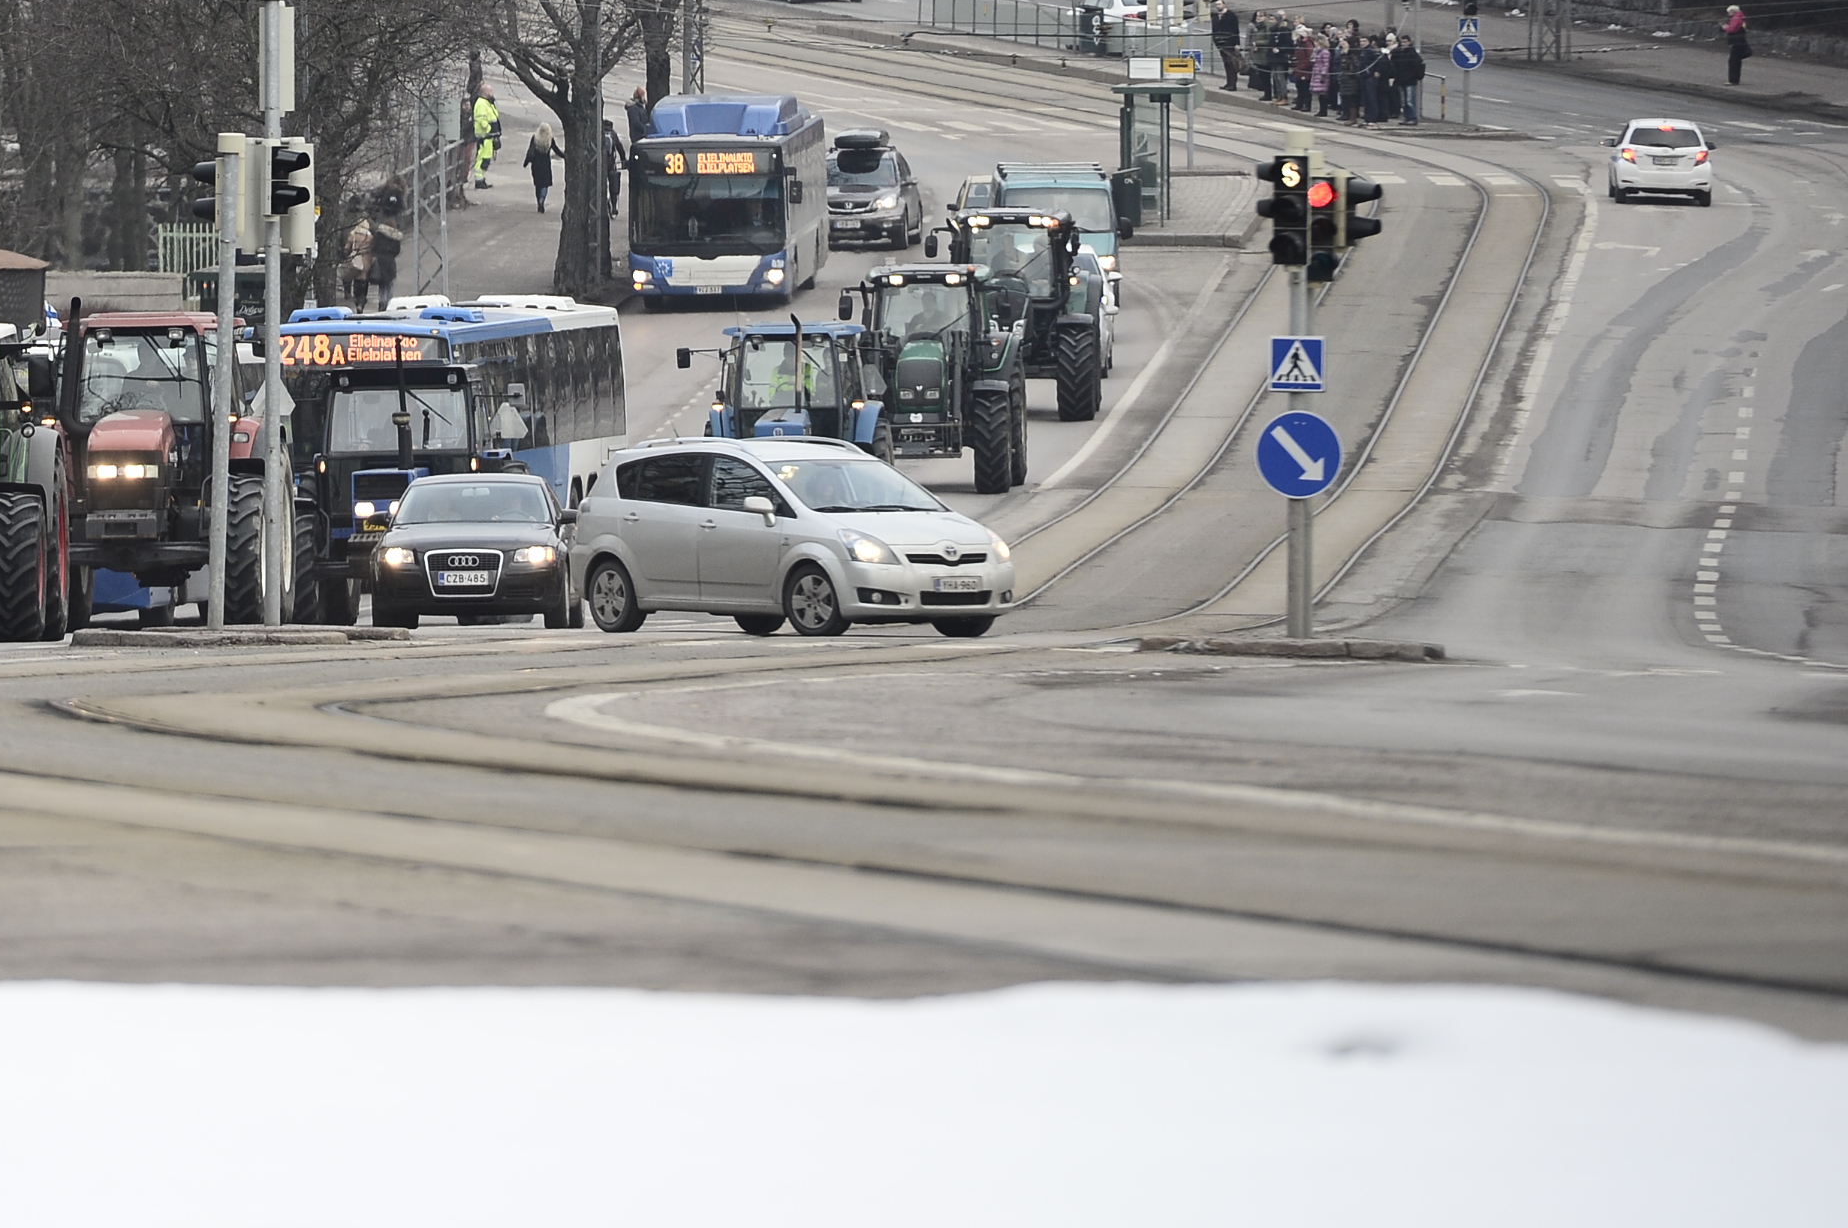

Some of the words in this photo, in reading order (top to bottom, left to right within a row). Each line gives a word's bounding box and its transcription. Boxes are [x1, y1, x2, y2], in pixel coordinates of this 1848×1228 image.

[697, 152, 754, 163] ELIELINAUKIO
[664, 153, 684, 175] 38
[697, 163, 755, 174] ELIELPLATSEN
[446, 573, 486, 583] CZB-485
